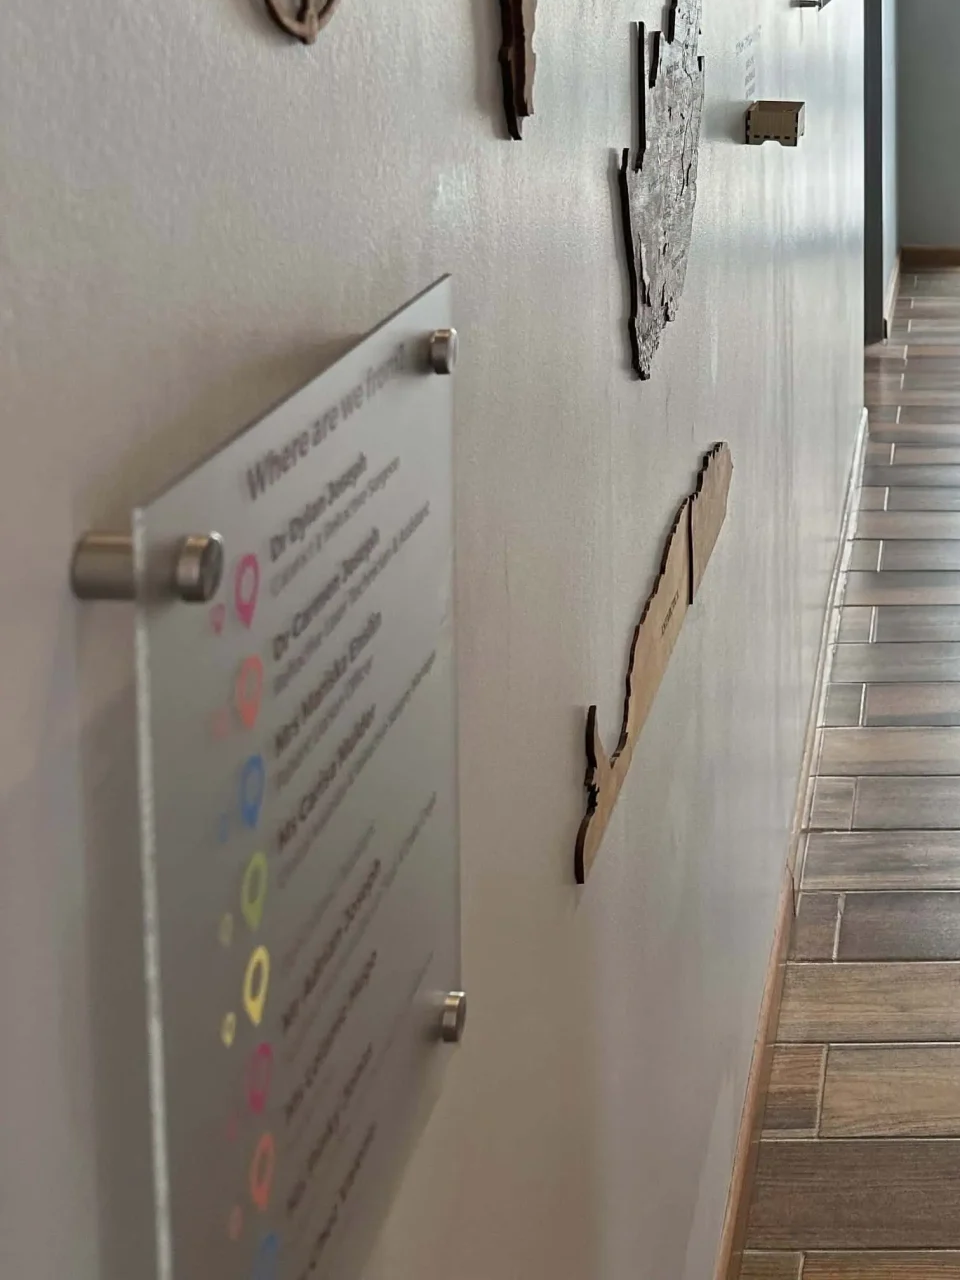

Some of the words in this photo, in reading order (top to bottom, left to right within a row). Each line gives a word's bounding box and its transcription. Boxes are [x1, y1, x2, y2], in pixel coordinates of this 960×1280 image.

[245, 430, 309, 502] Where
[311, 406, 339, 447] are
[339, 385, 364, 420] we
